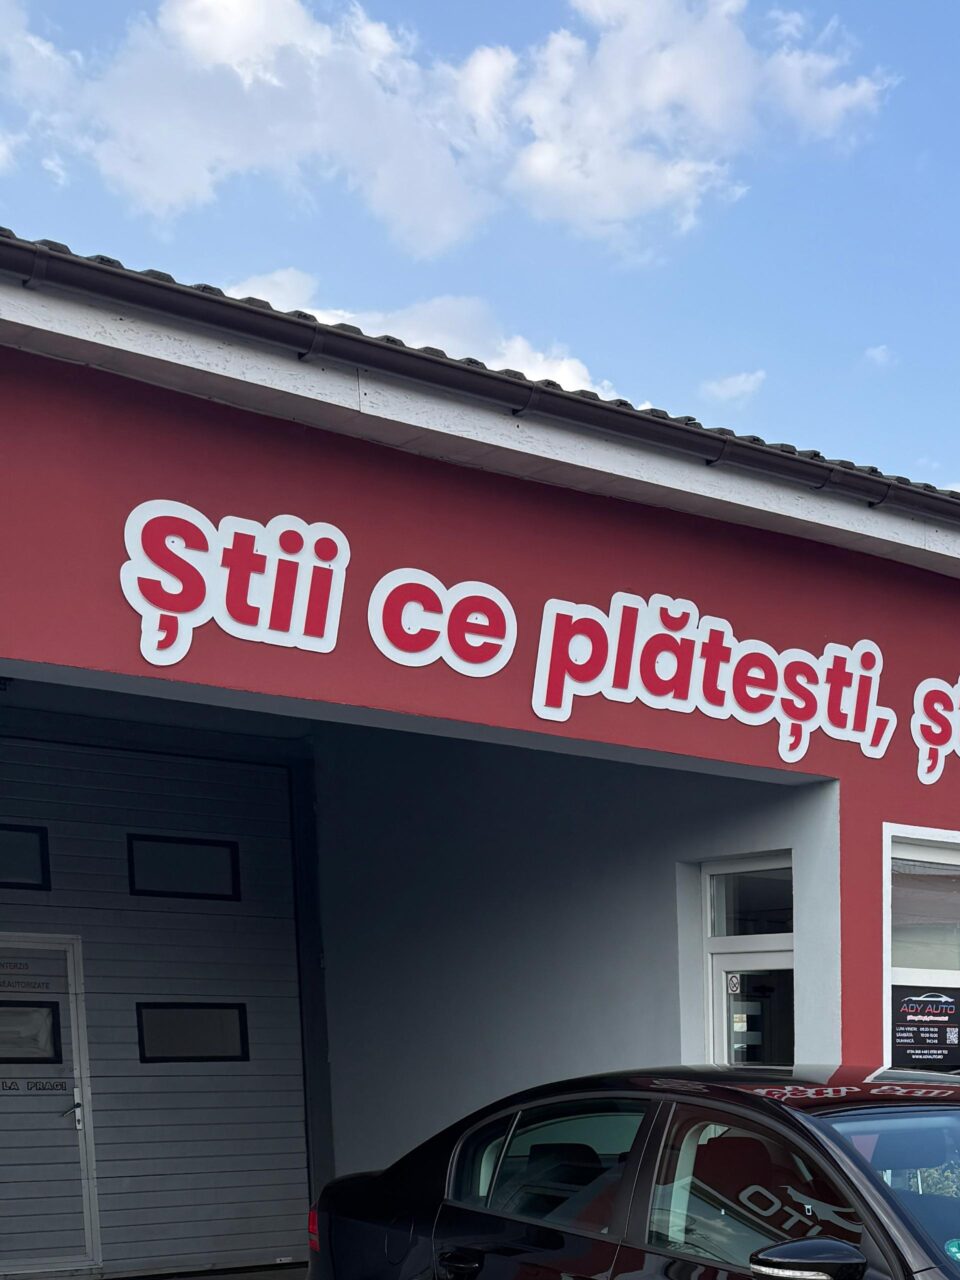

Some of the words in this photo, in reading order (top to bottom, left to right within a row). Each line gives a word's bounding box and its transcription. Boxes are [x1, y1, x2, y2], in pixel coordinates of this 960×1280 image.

[134, 511, 341, 653] Știi
[378, 579, 511, 667] ce
[541, 603, 891, 753] plătești,
[900, 1003, 924, 1013] ADY
[925, 1004, 956, 1014] AUTO
